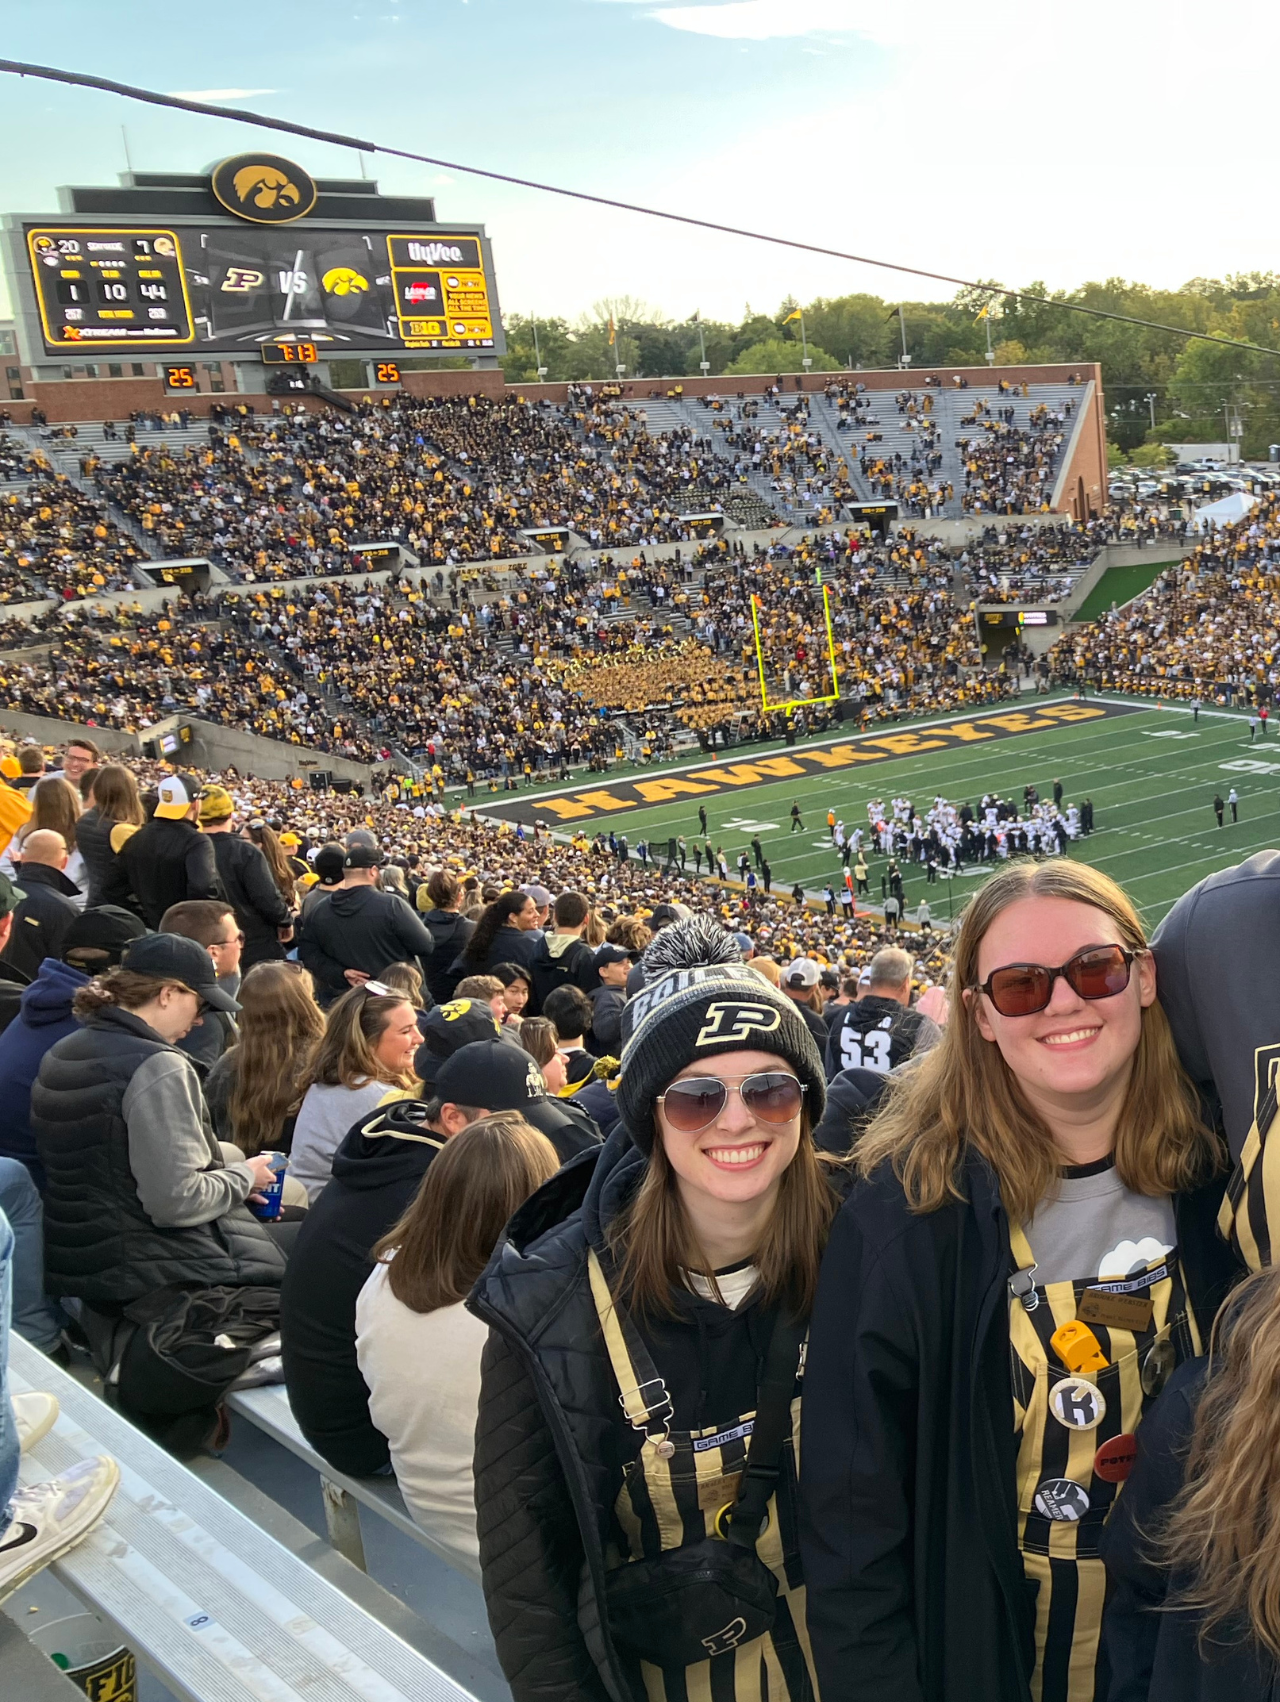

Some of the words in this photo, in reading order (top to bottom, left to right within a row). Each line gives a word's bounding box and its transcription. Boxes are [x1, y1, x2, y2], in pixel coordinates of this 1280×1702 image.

[57, 240, 80, 253] 20
[136, 240, 149, 254] 7
[104, 284, 127, 300] 10
[140, 284, 167, 300] 44
[279, 271, 308, 294] VS
[70, 284, 78, 301] 1
[277, 344, 318, 362] 7:13
[168, 368, 194, 387] 25
[377, 363, 400, 382] 25
[532, 704, 1107, 819] HAWKEYES
[696, 1002, 782, 1046] P
[840, 1026, 892, 1071] 53
[1094, 1283, 1133, 1293] AME
[1137, 1268, 1165, 1287] BIBS
[696, 1432, 739, 1449] GAME
[1041, 1489, 1064, 1521] REAMER
